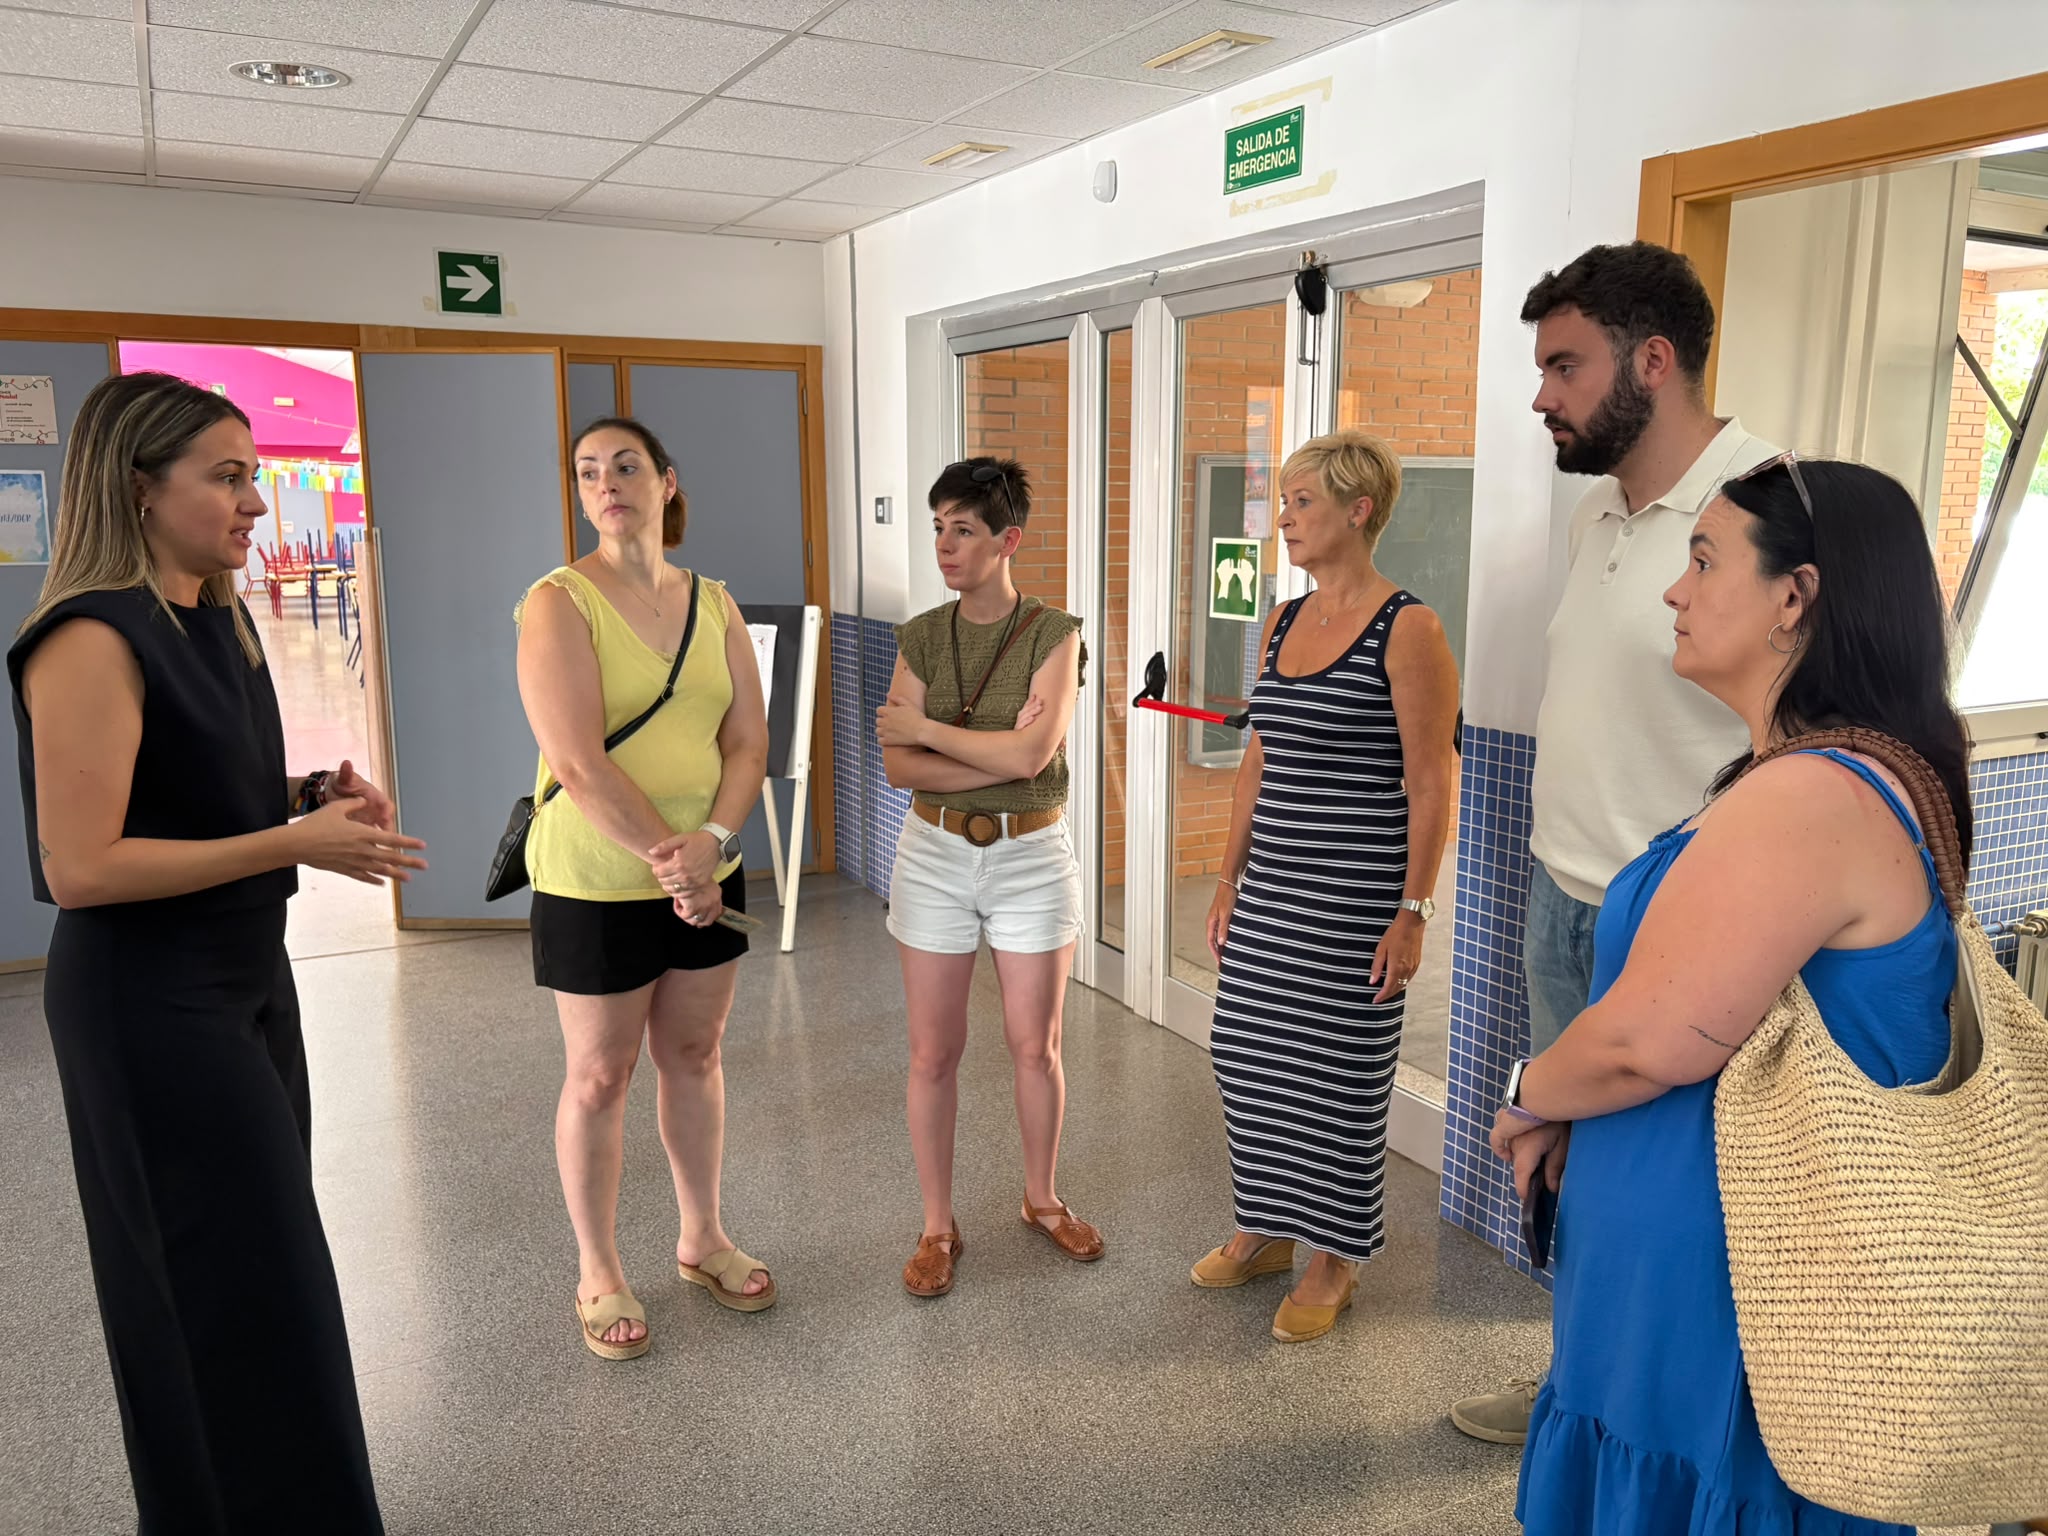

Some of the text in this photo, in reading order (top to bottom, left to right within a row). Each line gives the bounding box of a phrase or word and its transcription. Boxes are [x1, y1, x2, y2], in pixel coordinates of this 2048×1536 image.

[1236, 124, 1290, 157] SALIDA DE
[1229, 146, 1297, 181] EMERGENCIA
